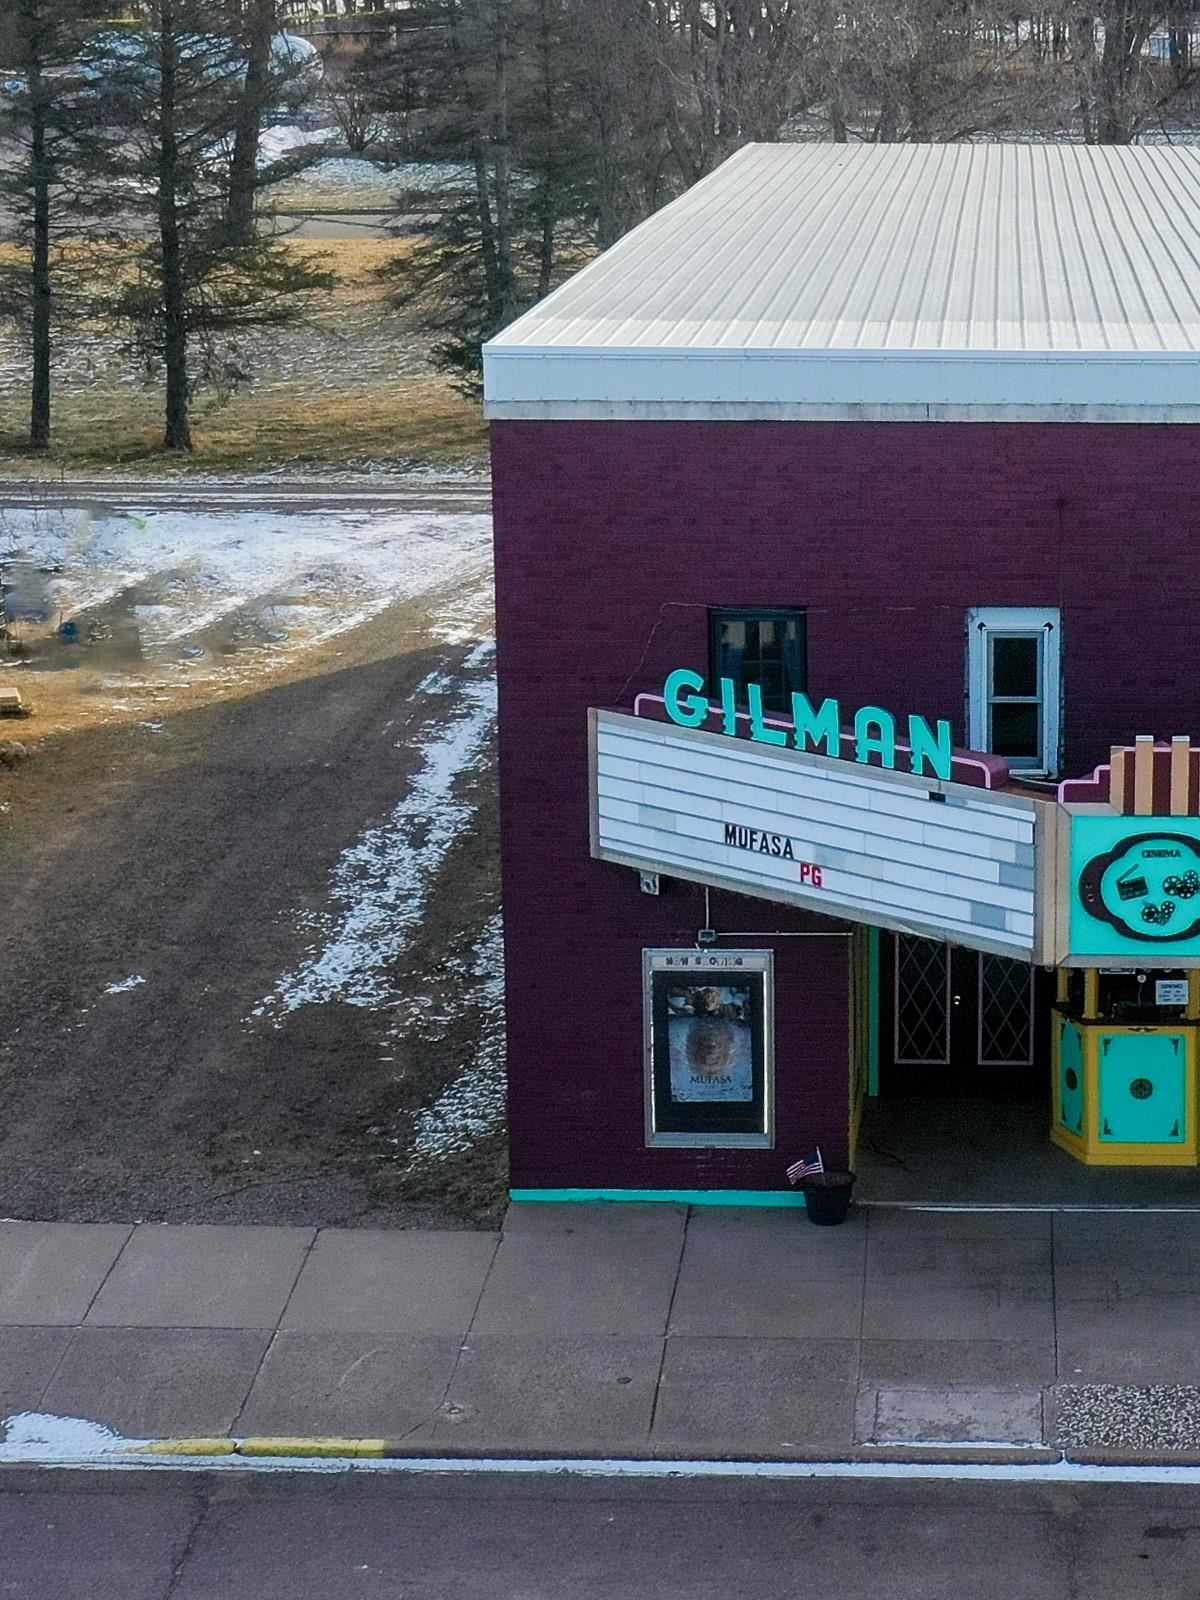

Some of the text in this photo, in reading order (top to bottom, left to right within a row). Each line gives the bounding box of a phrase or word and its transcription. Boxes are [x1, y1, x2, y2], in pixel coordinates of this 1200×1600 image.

[663, 668, 952, 780] GILMAN
[724, 823, 794, 860] MUFASA
[1141, 849, 1181, 858] CINEMA
[800, 862, 822, 888] PG
[690, 1074, 732, 1084] MUFASA
